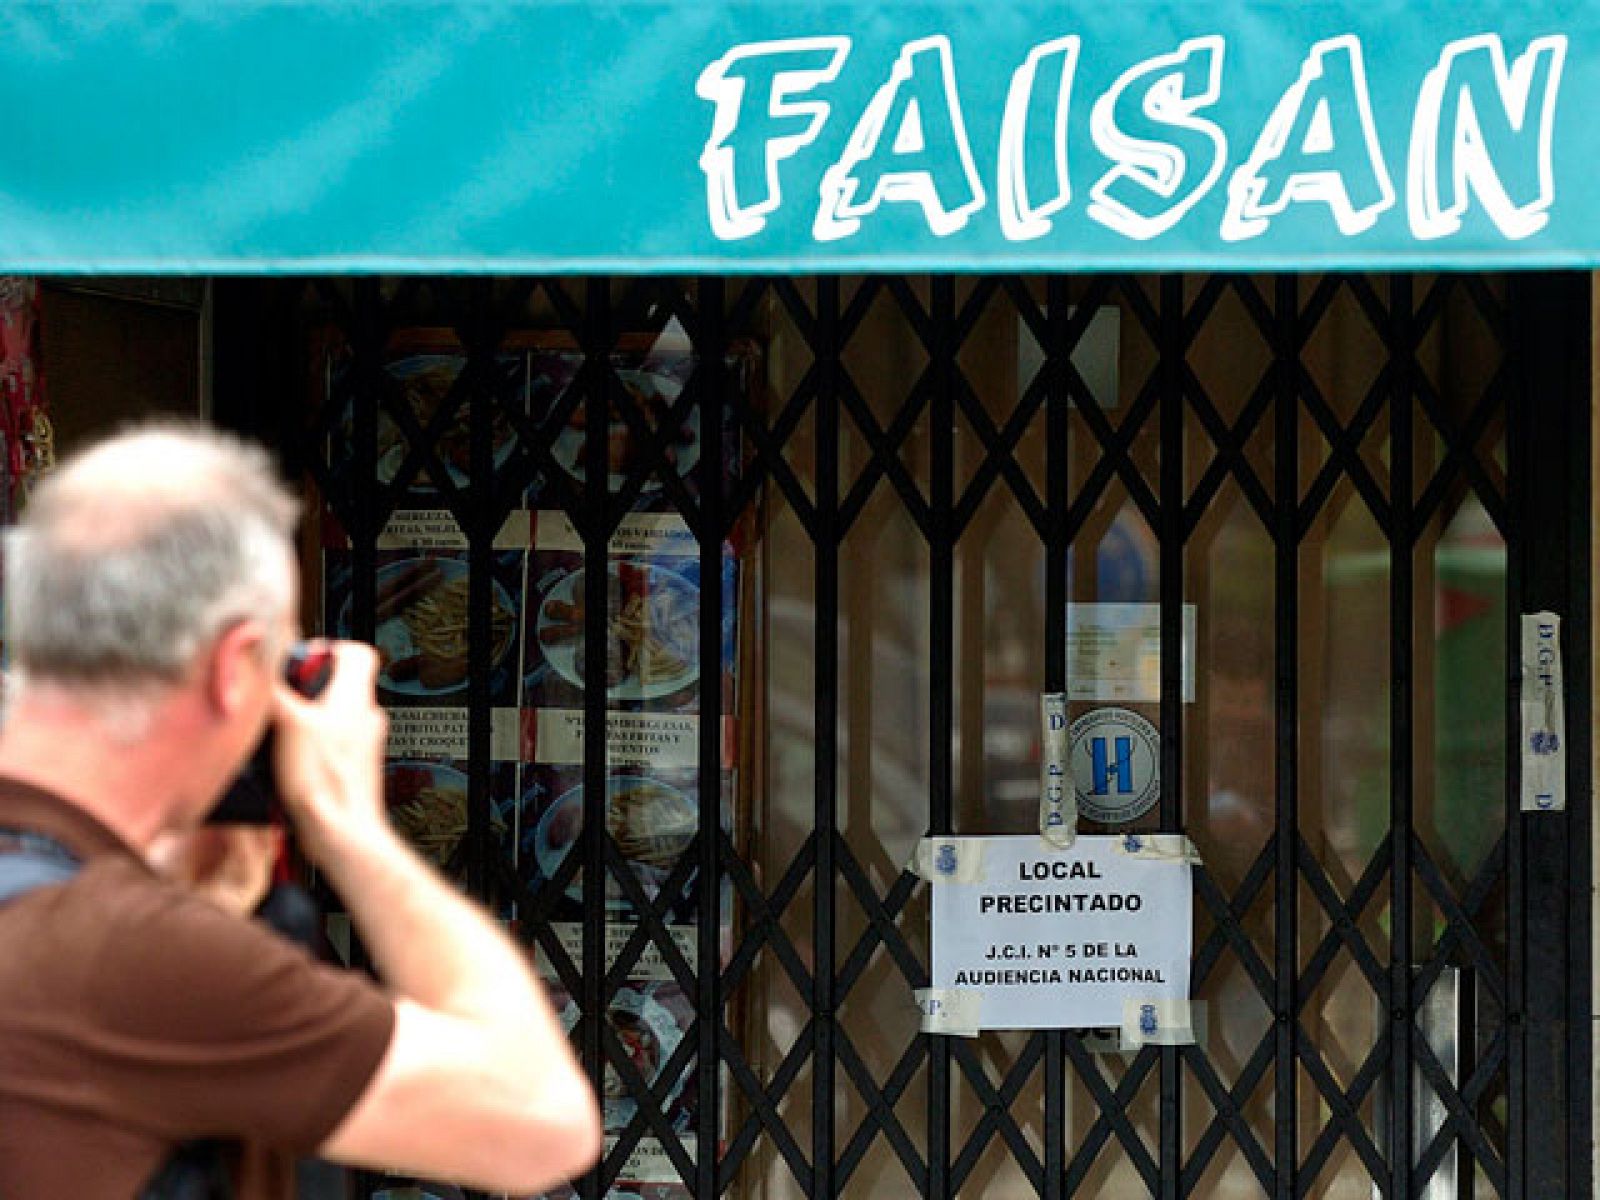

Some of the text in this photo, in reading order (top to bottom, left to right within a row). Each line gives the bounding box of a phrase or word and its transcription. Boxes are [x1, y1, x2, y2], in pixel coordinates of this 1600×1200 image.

[695, 34, 1568, 240] FAISAN
[1019, 861, 1102, 881] LOCAL
[979, 893, 1142, 914] PRECINTADO
[985, 943, 1031, 960] J.C.I.
[1065, 943, 1076, 959] 5
[1084, 942, 1108, 958] DE
[1114, 942, 1138, 958] LA
[954, 967, 1166, 986] AUDIENCIA NACIONAL
